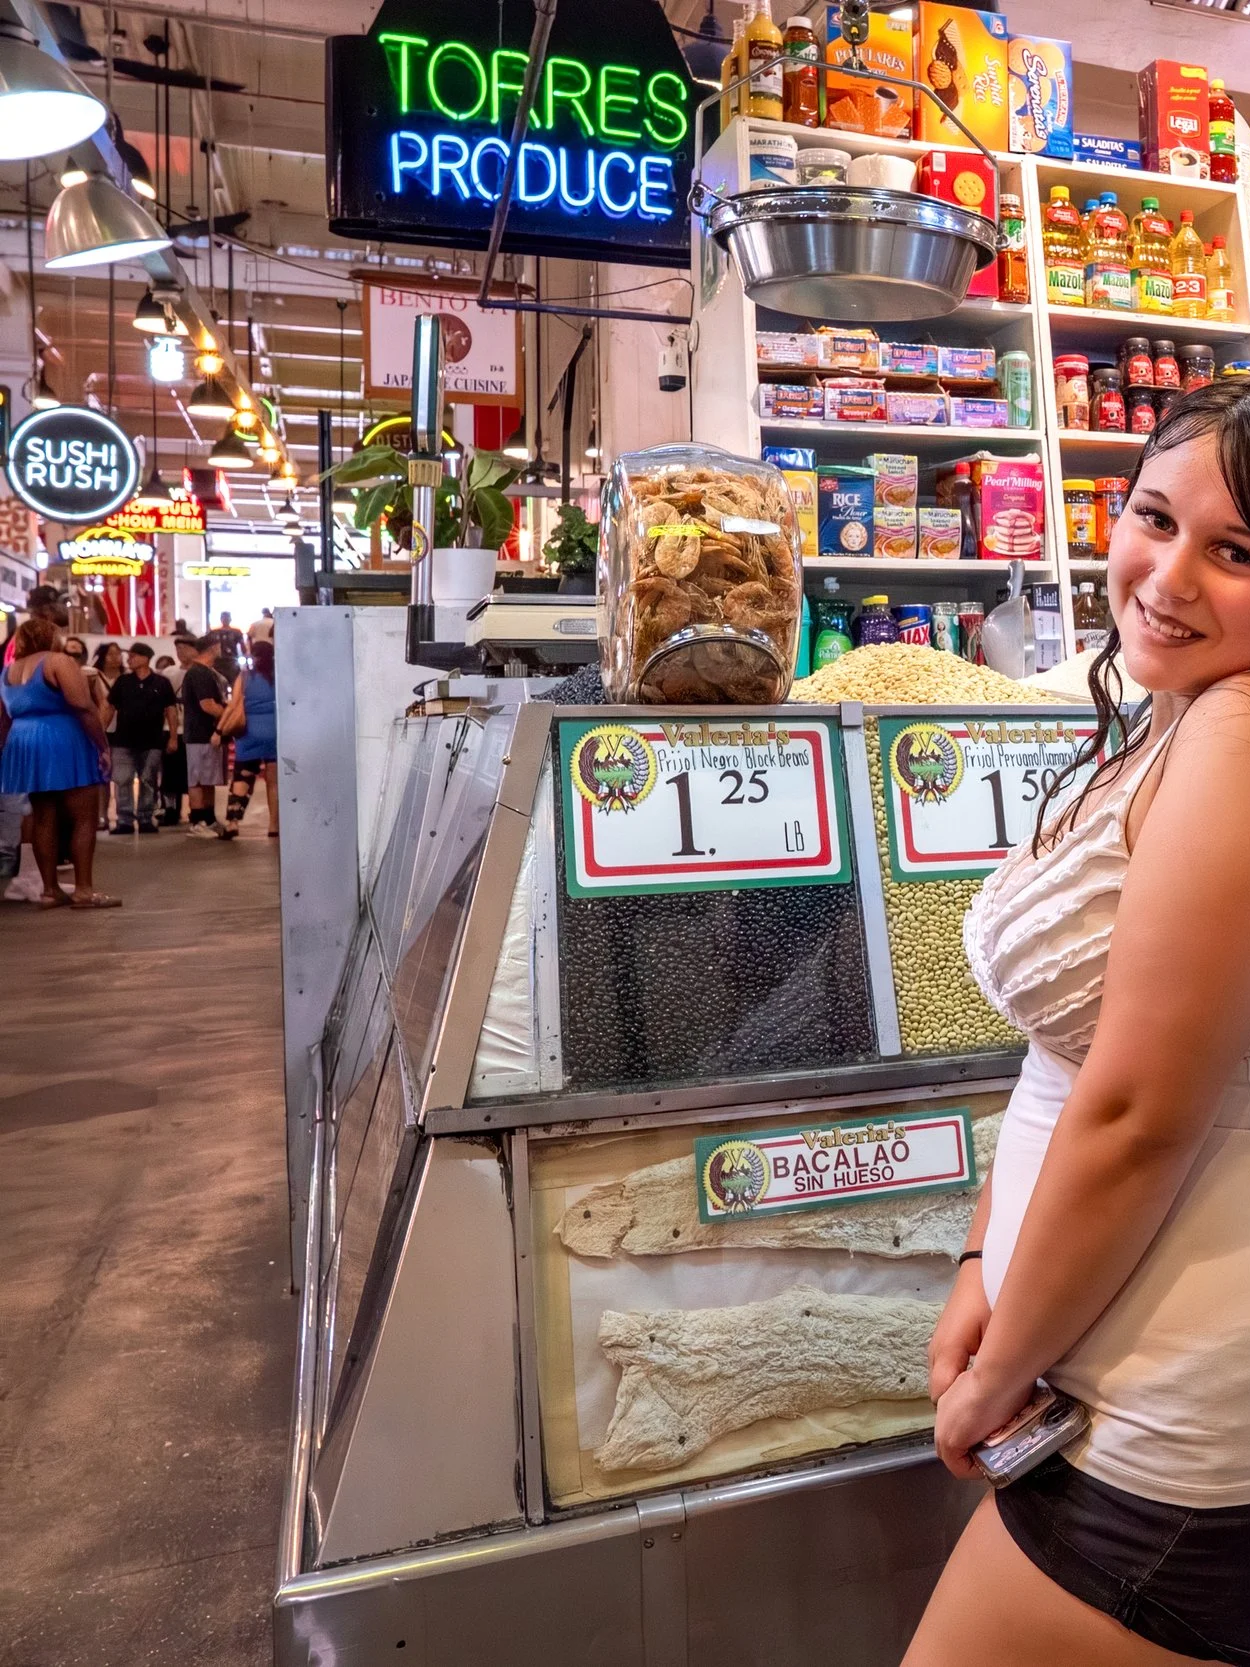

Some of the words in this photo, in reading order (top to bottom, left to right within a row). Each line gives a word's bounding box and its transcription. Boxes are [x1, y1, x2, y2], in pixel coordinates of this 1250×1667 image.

[379, 33, 687, 145] TORRES
[1081, 137, 1125, 152] SALADITAS
[391, 131, 673, 216] PRODUCE
[380, 287, 468, 312] BENTO
[1145, 279, 1172, 299] Mazol
[383, 373, 453, 388] JAPE
[454, 376, 507, 393] CUISINE
[26, 437, 117, 467] SUSHI
[376, 434, 412, 449] DIST
[26, 463, 118, 492] RUSH
[984, 475, 1011, 487] Pearl
[1011, 477, 1043, 492] Milling
[832, 493, 862, 507] RICE
[161, 515, 203, 530] MEIN
[659, 722, 791, 748] Valeria's
[963, 720, 1077, 746] Valeria's
[964, 745, 996, 769] Frijol
[784, 820, 805, 853] LB
[800, 1120, 907, 1151] Valeria's
[772, 1140, 910, 1180] BACALAO
[794, 1175, 825, 1193] SIN
[833, 1166, 895, 1188] HUESO
